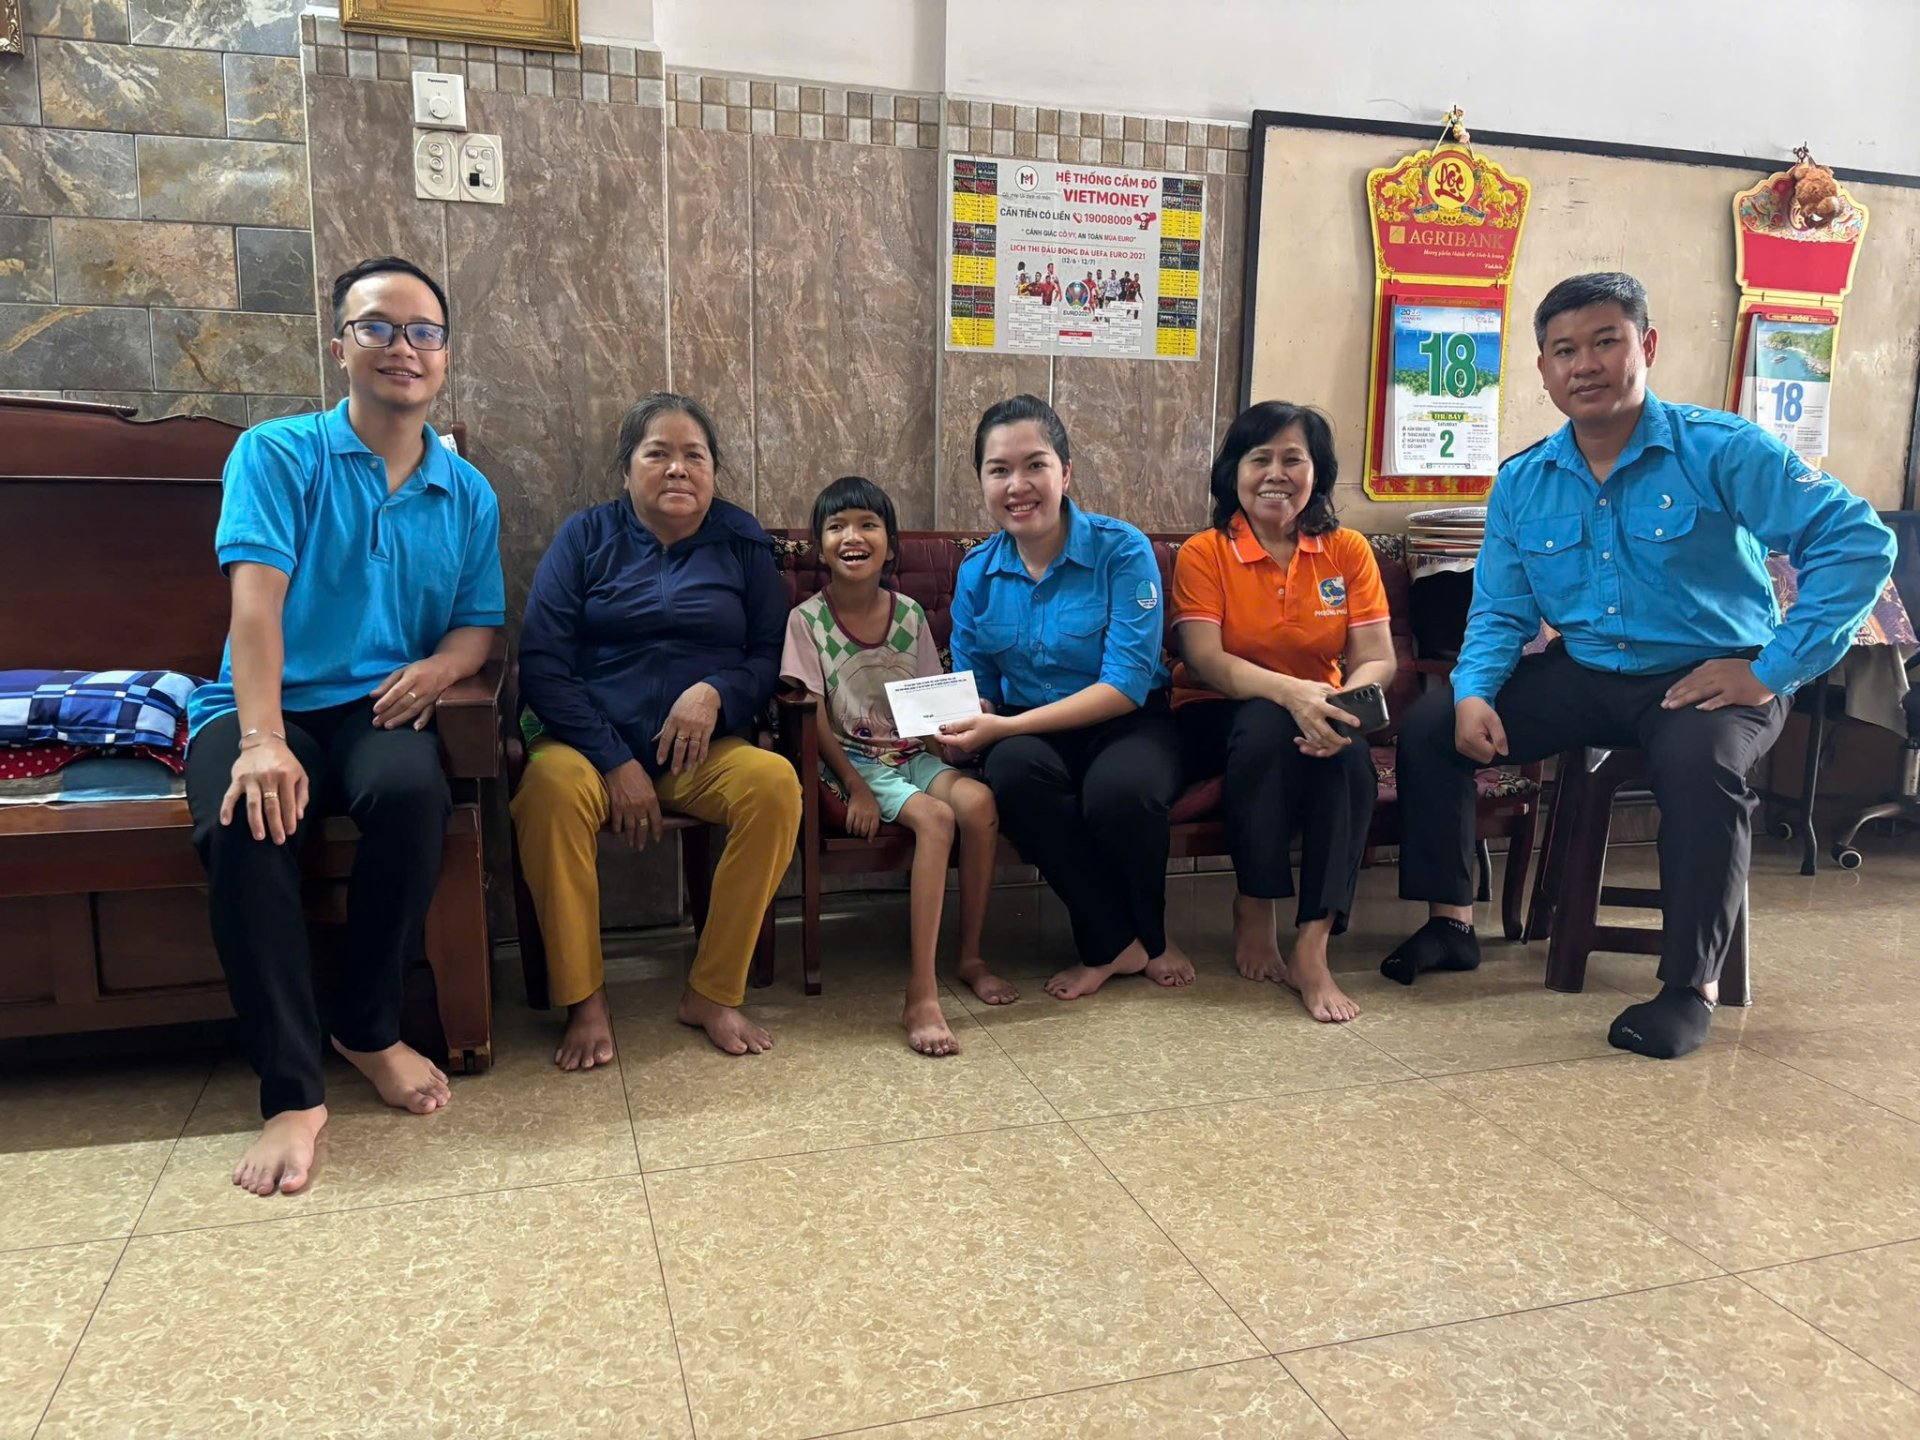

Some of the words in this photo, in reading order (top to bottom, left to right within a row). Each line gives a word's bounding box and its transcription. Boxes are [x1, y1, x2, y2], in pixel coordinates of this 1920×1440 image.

[1056, 170, 1071, 185] HỆ
[1073, 171, 1112, 186] THỐNG
[1063, 188, 1149, 208] VIETMONEY
[1039, 210, 1051, 220] CÓ
[1084, 213, 1133, 226] 19008009
[1409, 229, 1506, 249] AGRIBANK
[1091, 249, 1108, 257] UEFA
[1109, 250, 1128, 259] EURO
[1129, 251, 1146, 260] 2021
[1420, 331, 1477, 398] 18
[1771, 381, 1804, 423] 18
[1440, 429, 1454, 458] 2
